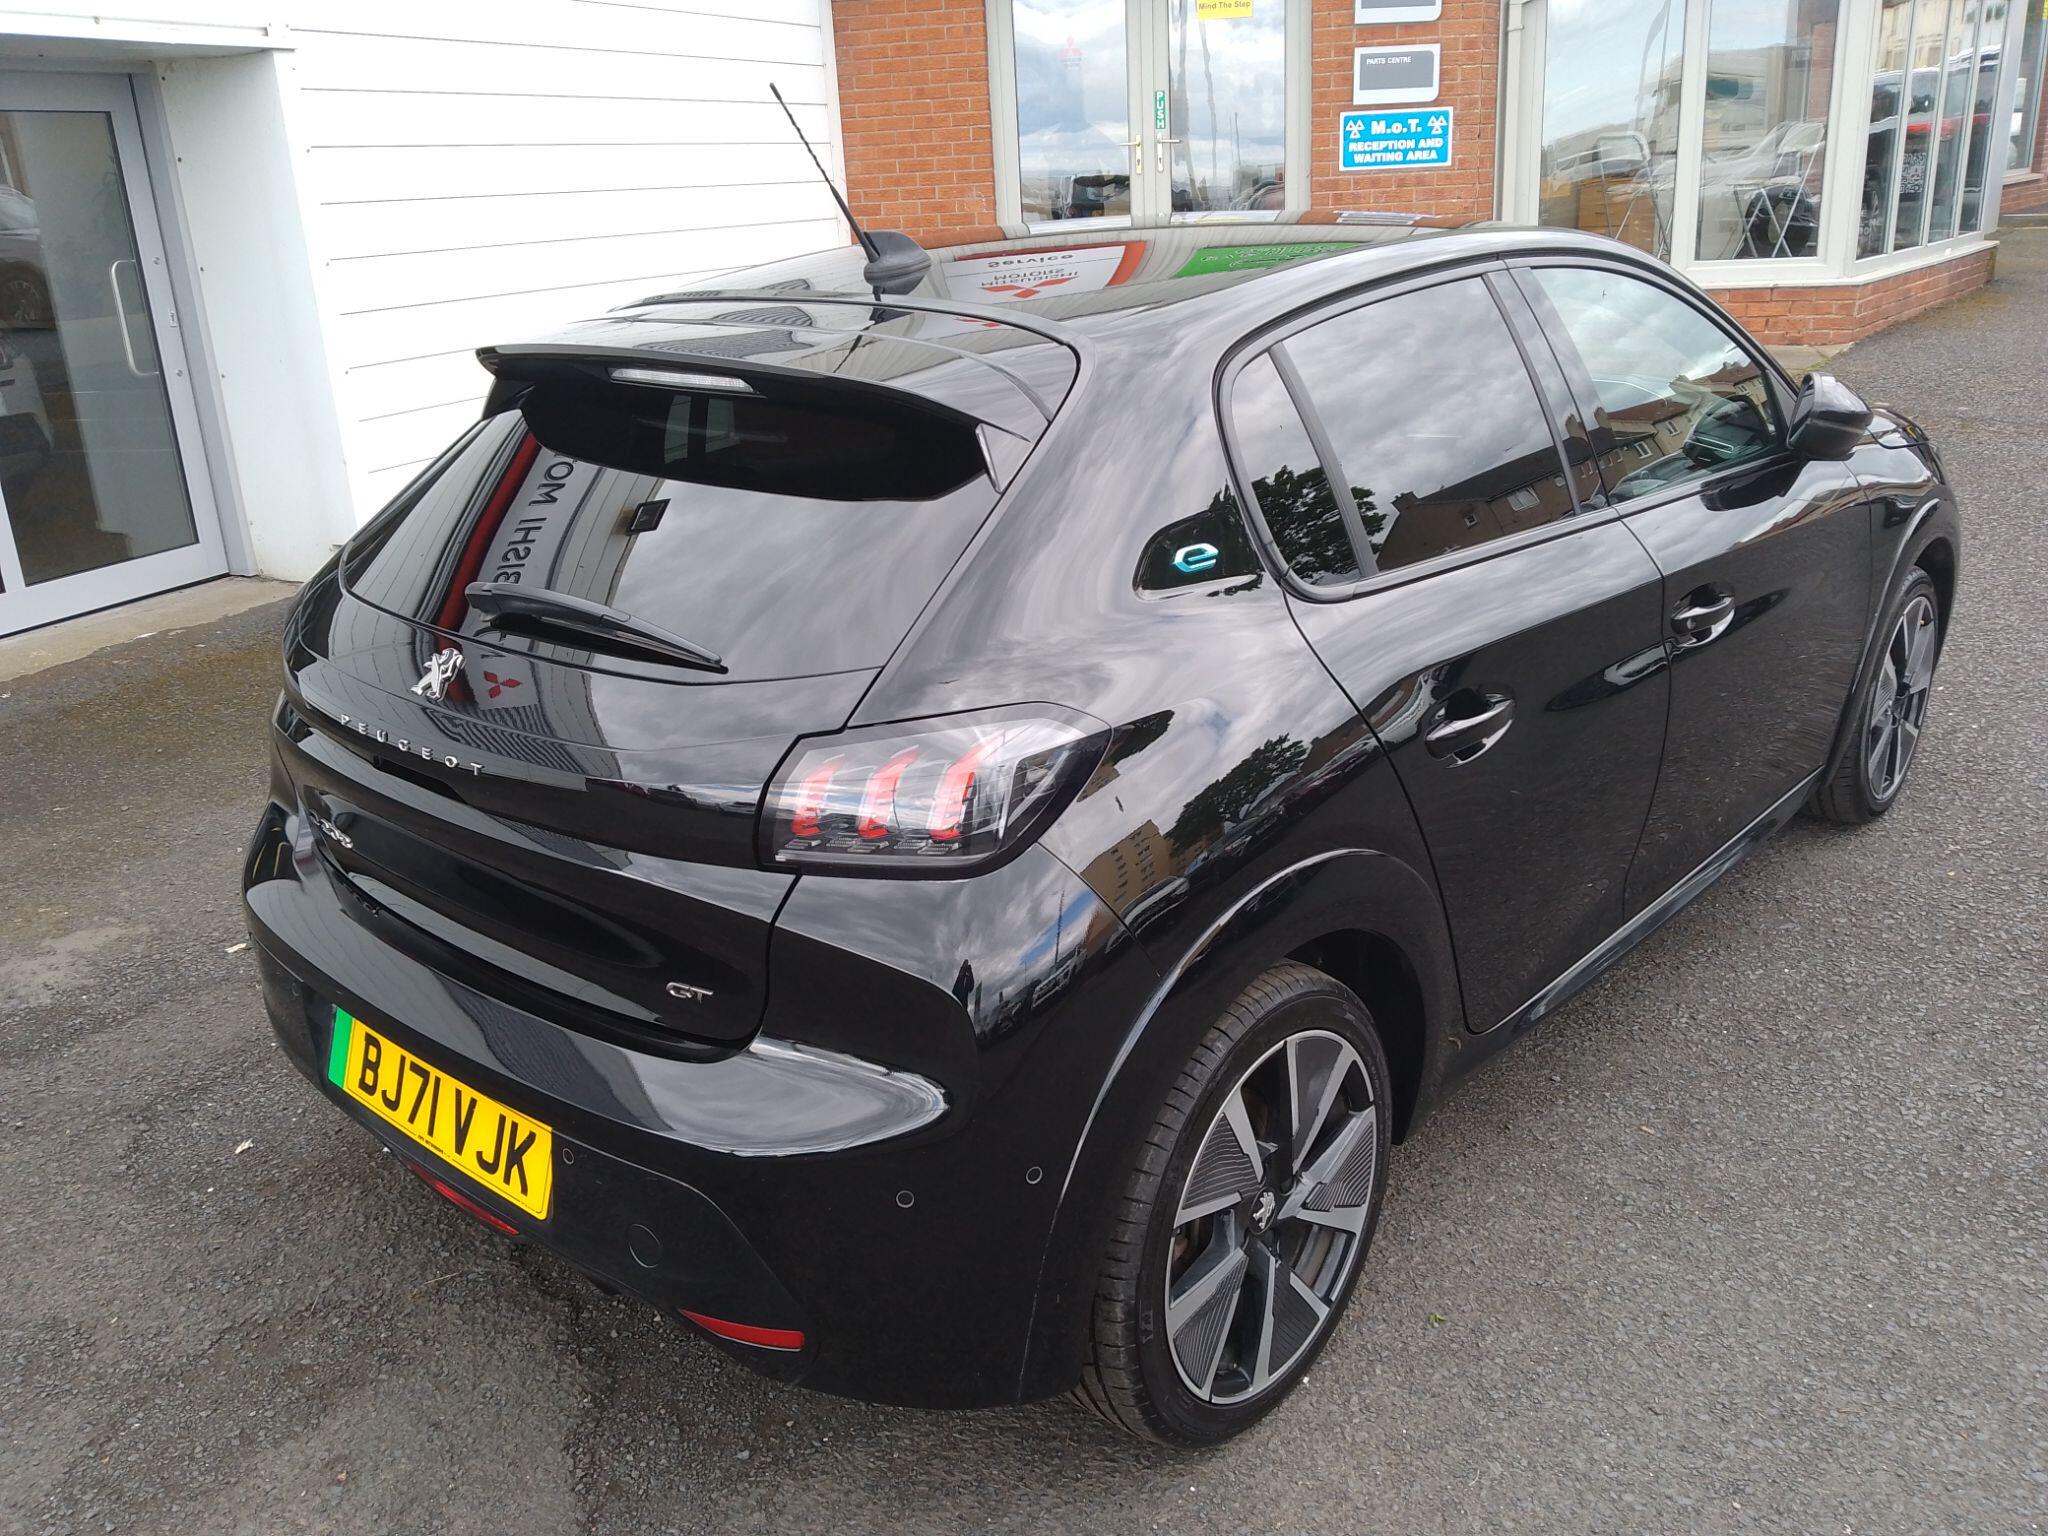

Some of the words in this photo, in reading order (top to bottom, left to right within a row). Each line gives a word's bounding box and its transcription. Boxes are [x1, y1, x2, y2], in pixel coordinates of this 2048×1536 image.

[1199, 2, 1217, 10] Mind
[1219, 1, 1233, 9] The
[1234, 0, 1251, 8] Step
[1366, 57, 1386, 65] PARTS
[1387, 56, 1412, 64] CENTRE
[1156, 91, 1165, 129] PUSH
[1371, 118, 1422, 135] M.o.T.
[1348, 139, 1416, 152] RECEPTION
[1418, 137, 1443, 148] AND
[1354, 151, 1403, 163] WAITING
[1406, 150, 1438, 161] AREA
[338, 714, 485, 777] PEUGEOT
[666, 980, 714, 1000] GT
[358, 1031, 442, 1138] BJ71
[454, 1086, 537, 1197] VJK
